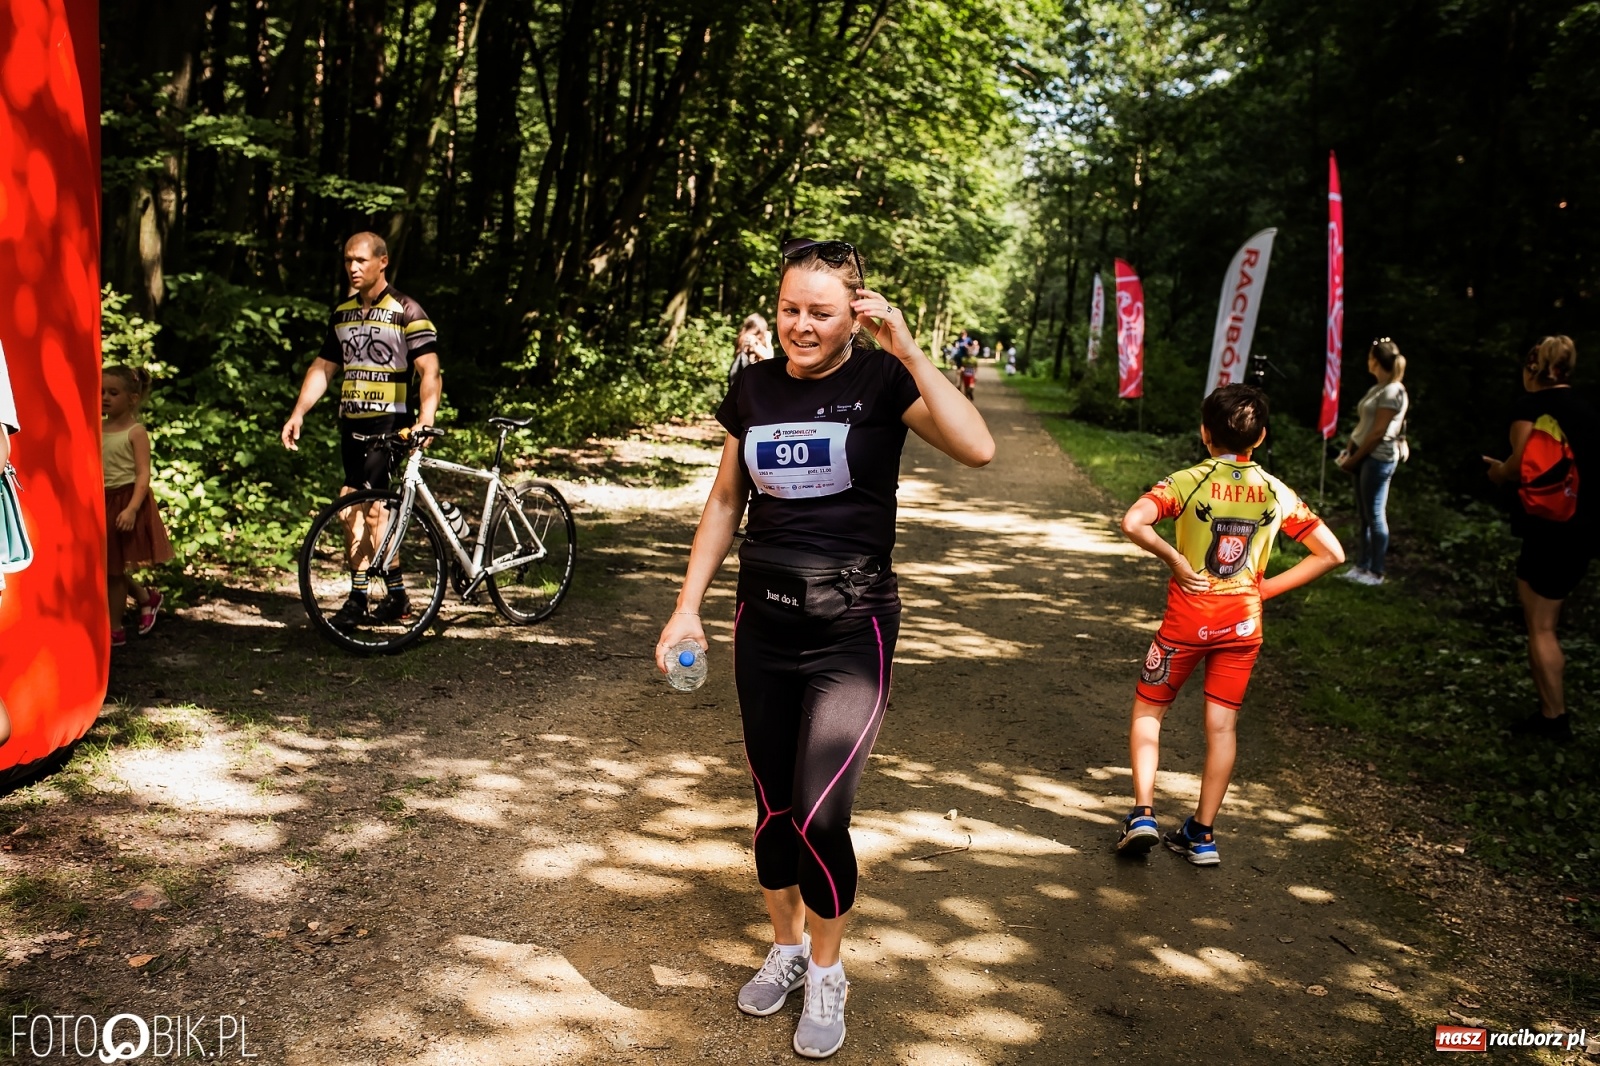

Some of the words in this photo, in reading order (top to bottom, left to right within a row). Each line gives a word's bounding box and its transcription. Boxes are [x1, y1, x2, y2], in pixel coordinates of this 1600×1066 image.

[368, 308, 394, 324] ONE
[1217, 247, 1261, 388] RACIBÓR
[371, 372, 390, 382] FAT
[363, 391, 385, 401] YOU
[775, 442, 809, 465] 90
[766, 589, 780, 602] Just
[781, 594, 791, 604] do
[791, 596, 799, 607] it.
